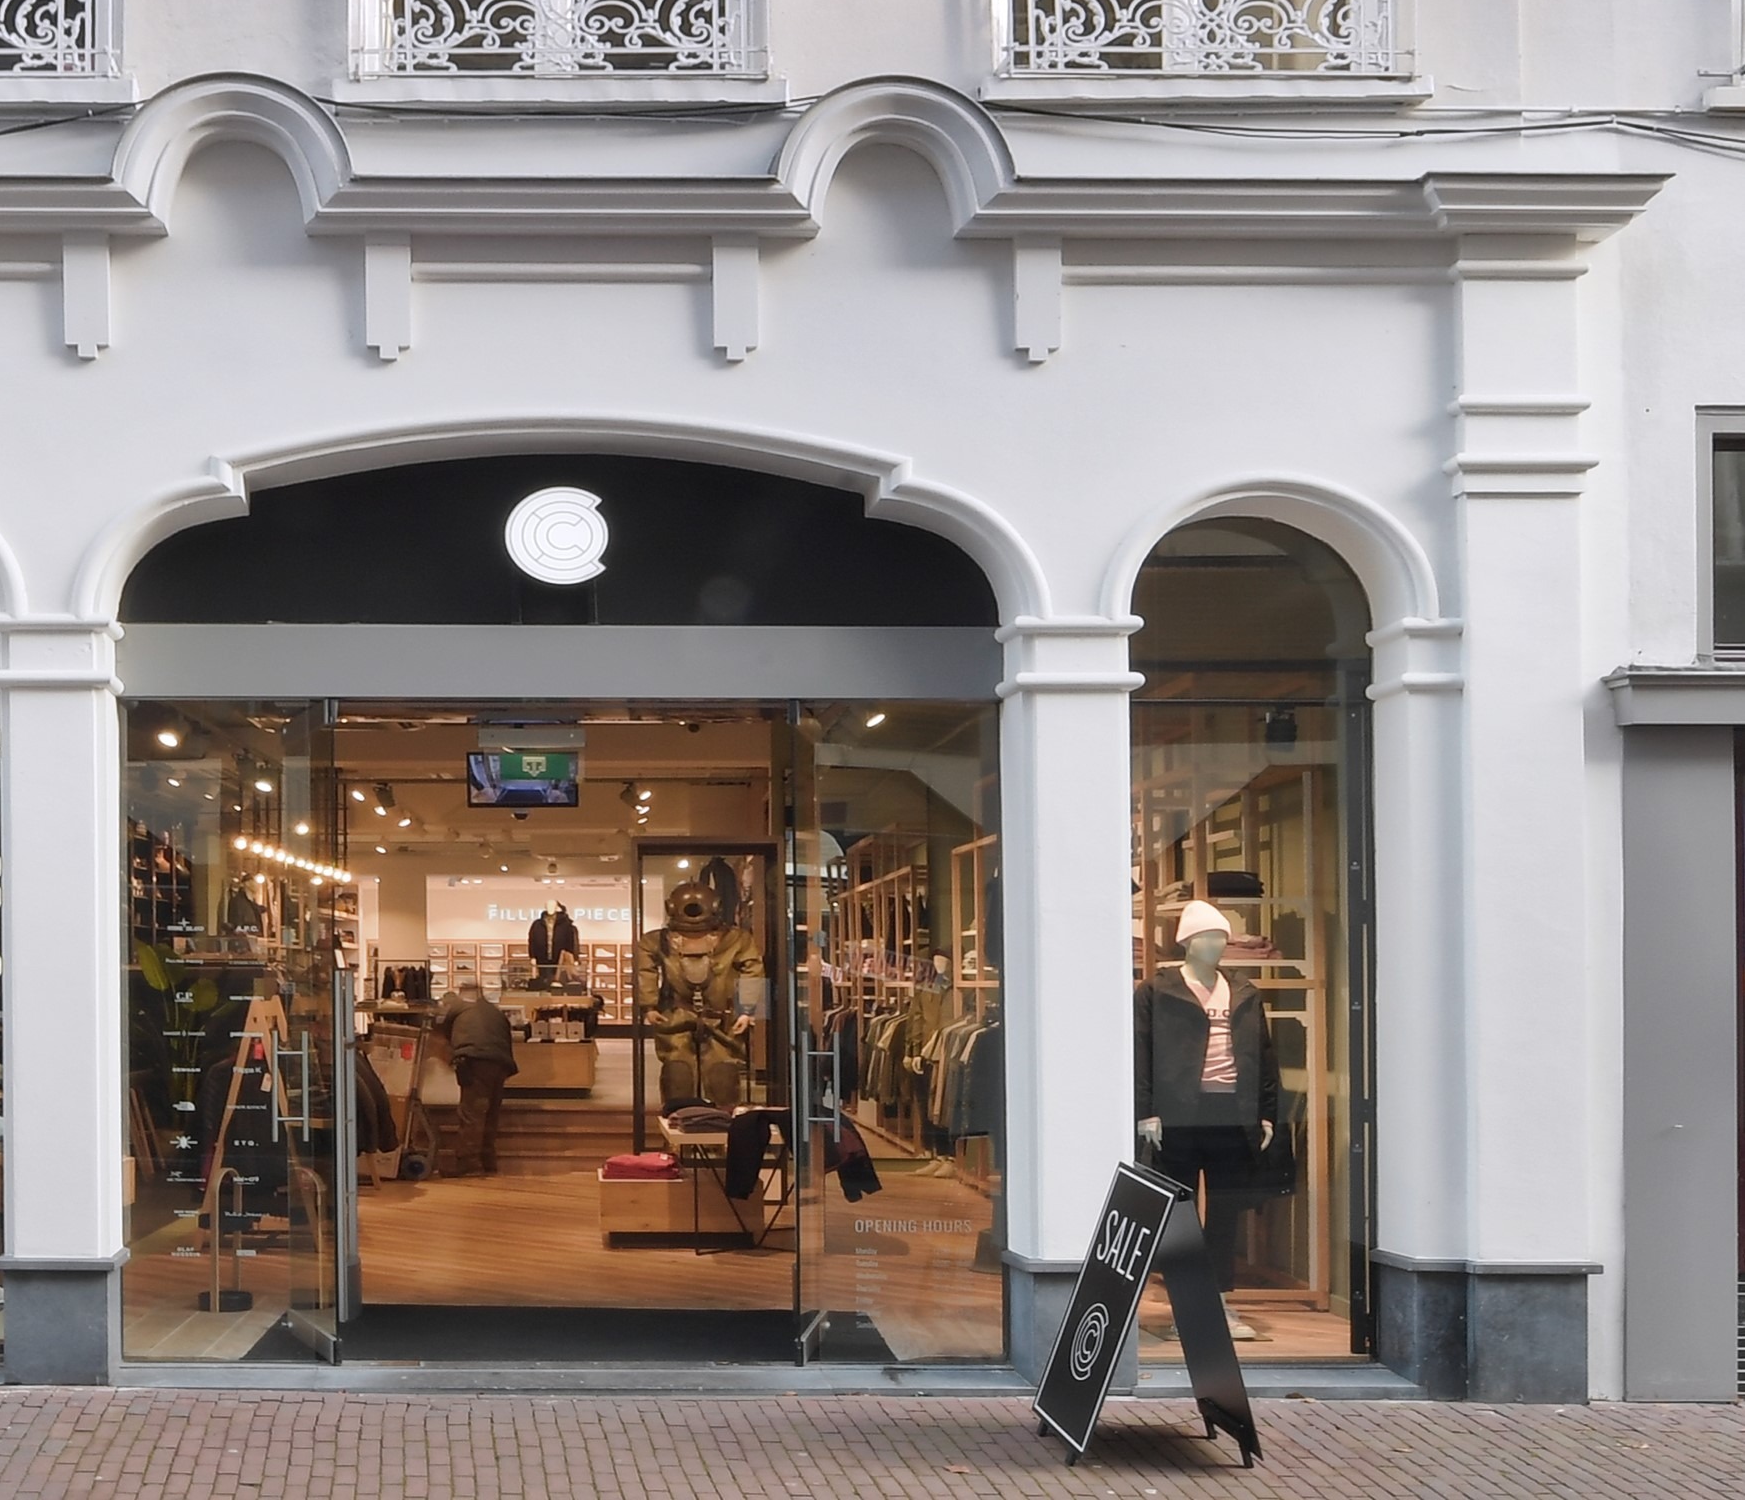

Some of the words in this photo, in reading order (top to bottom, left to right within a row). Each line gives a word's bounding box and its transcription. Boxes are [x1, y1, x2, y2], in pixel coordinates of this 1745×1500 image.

[855, 1219, 917, 1233] OPENING
[923, 1219, 972, 1233] HOURS
[1096, 1209, 1151, 1281] SALE
